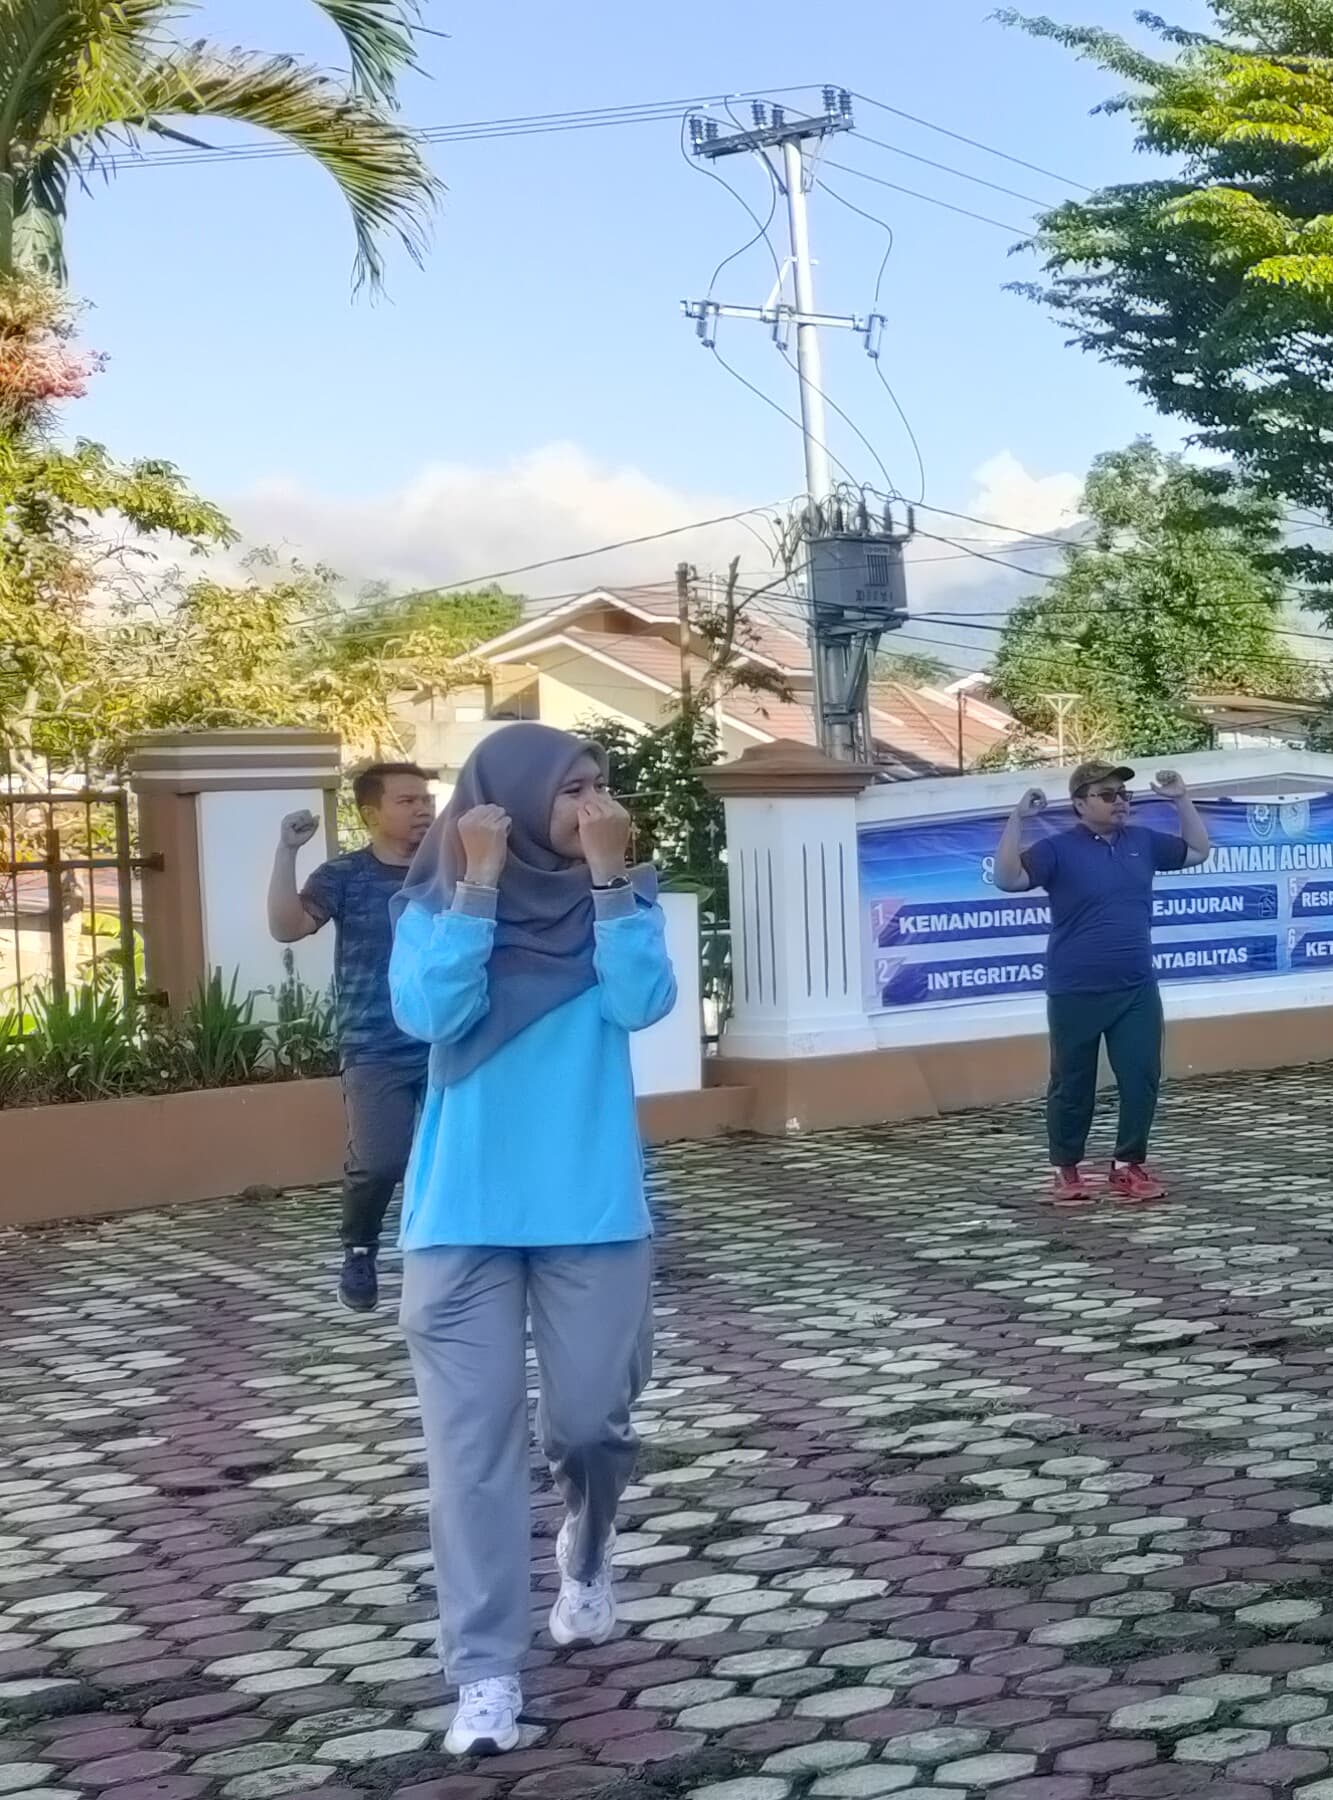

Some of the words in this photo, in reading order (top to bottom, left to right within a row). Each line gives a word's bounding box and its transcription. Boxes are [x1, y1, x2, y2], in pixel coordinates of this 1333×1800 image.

[1155, 845, 1275, 876] KAMAH
[1289, 877, 1298, 897] 5
[874, 903, 884, 925] 1
[1153, 896, 1244, 916] EJUJURAN
[900, 907, 1051, 934] KEMANDIRIAN
[1288, 928, 1296, 949] 6
[1152, 947, 1248, 969] NTABILITAS
[878, 960, 889, 982] 2
[928, 964, 1044, 990] INTEGRITAS
